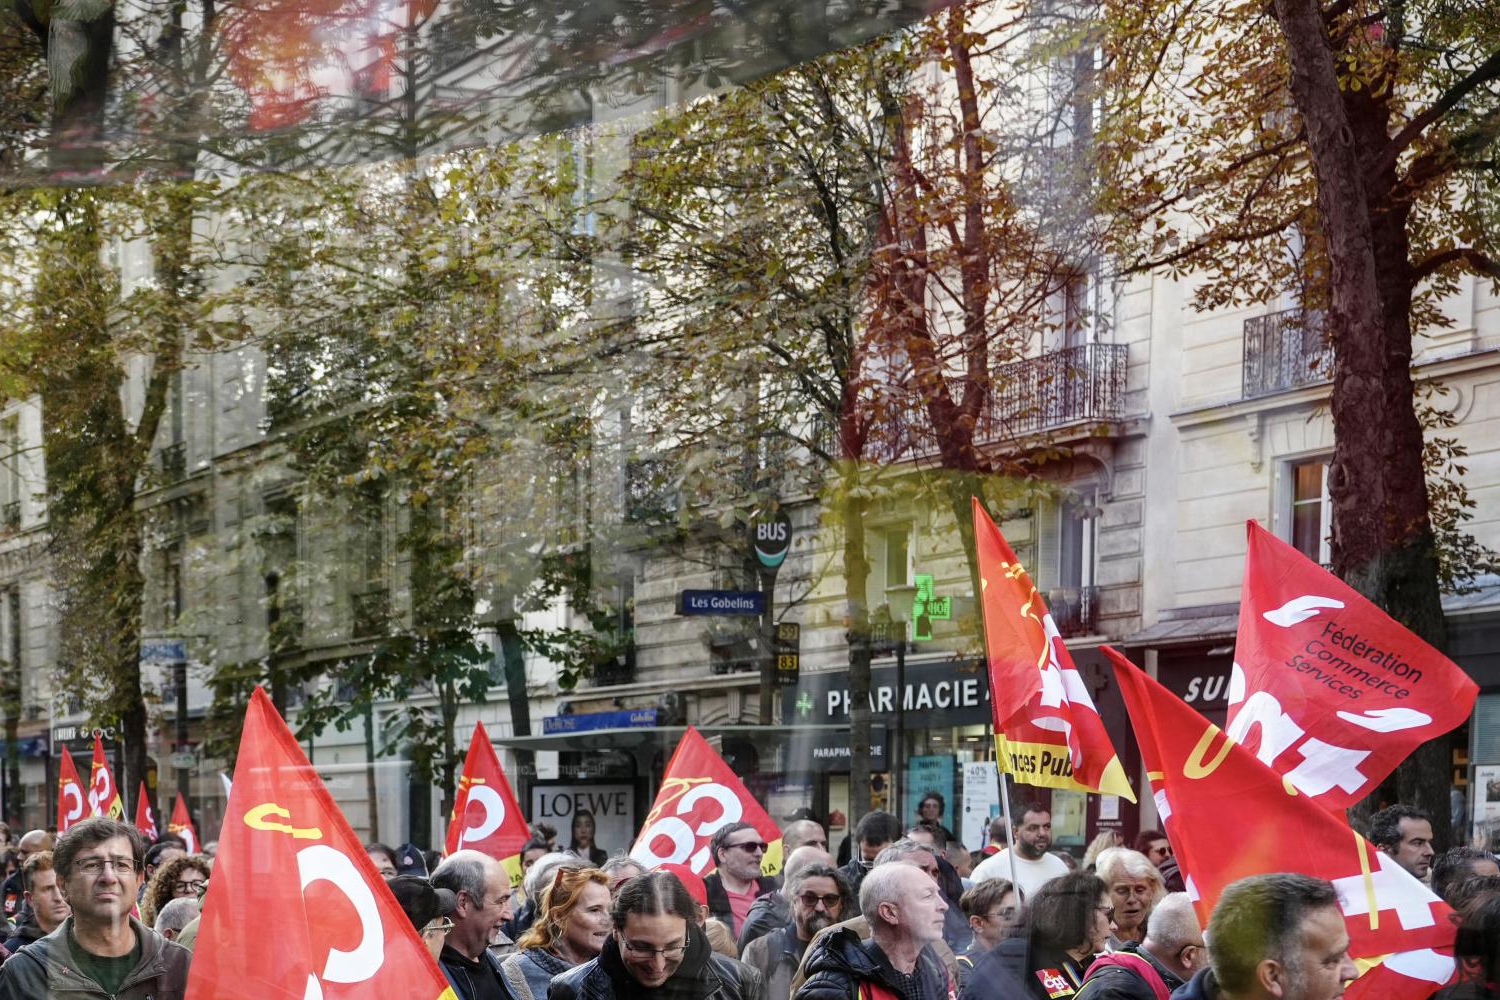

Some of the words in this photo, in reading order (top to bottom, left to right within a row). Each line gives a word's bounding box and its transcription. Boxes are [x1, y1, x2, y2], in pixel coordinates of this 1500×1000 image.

[757, 522, 786, 540] BUS
[691, 597, 708, 608] Les
[711, 597, 754, 609] Gobelins
[781, 624, 796, 639] 59
[780, 656, 795, 669] 83
[1321, 620, 1423, 684] Fédération
[1285, 655, 1364, 699] Services
[1305, 640, 1411, 700] Commerce
[540, 793, 627, 817] LOEWE
